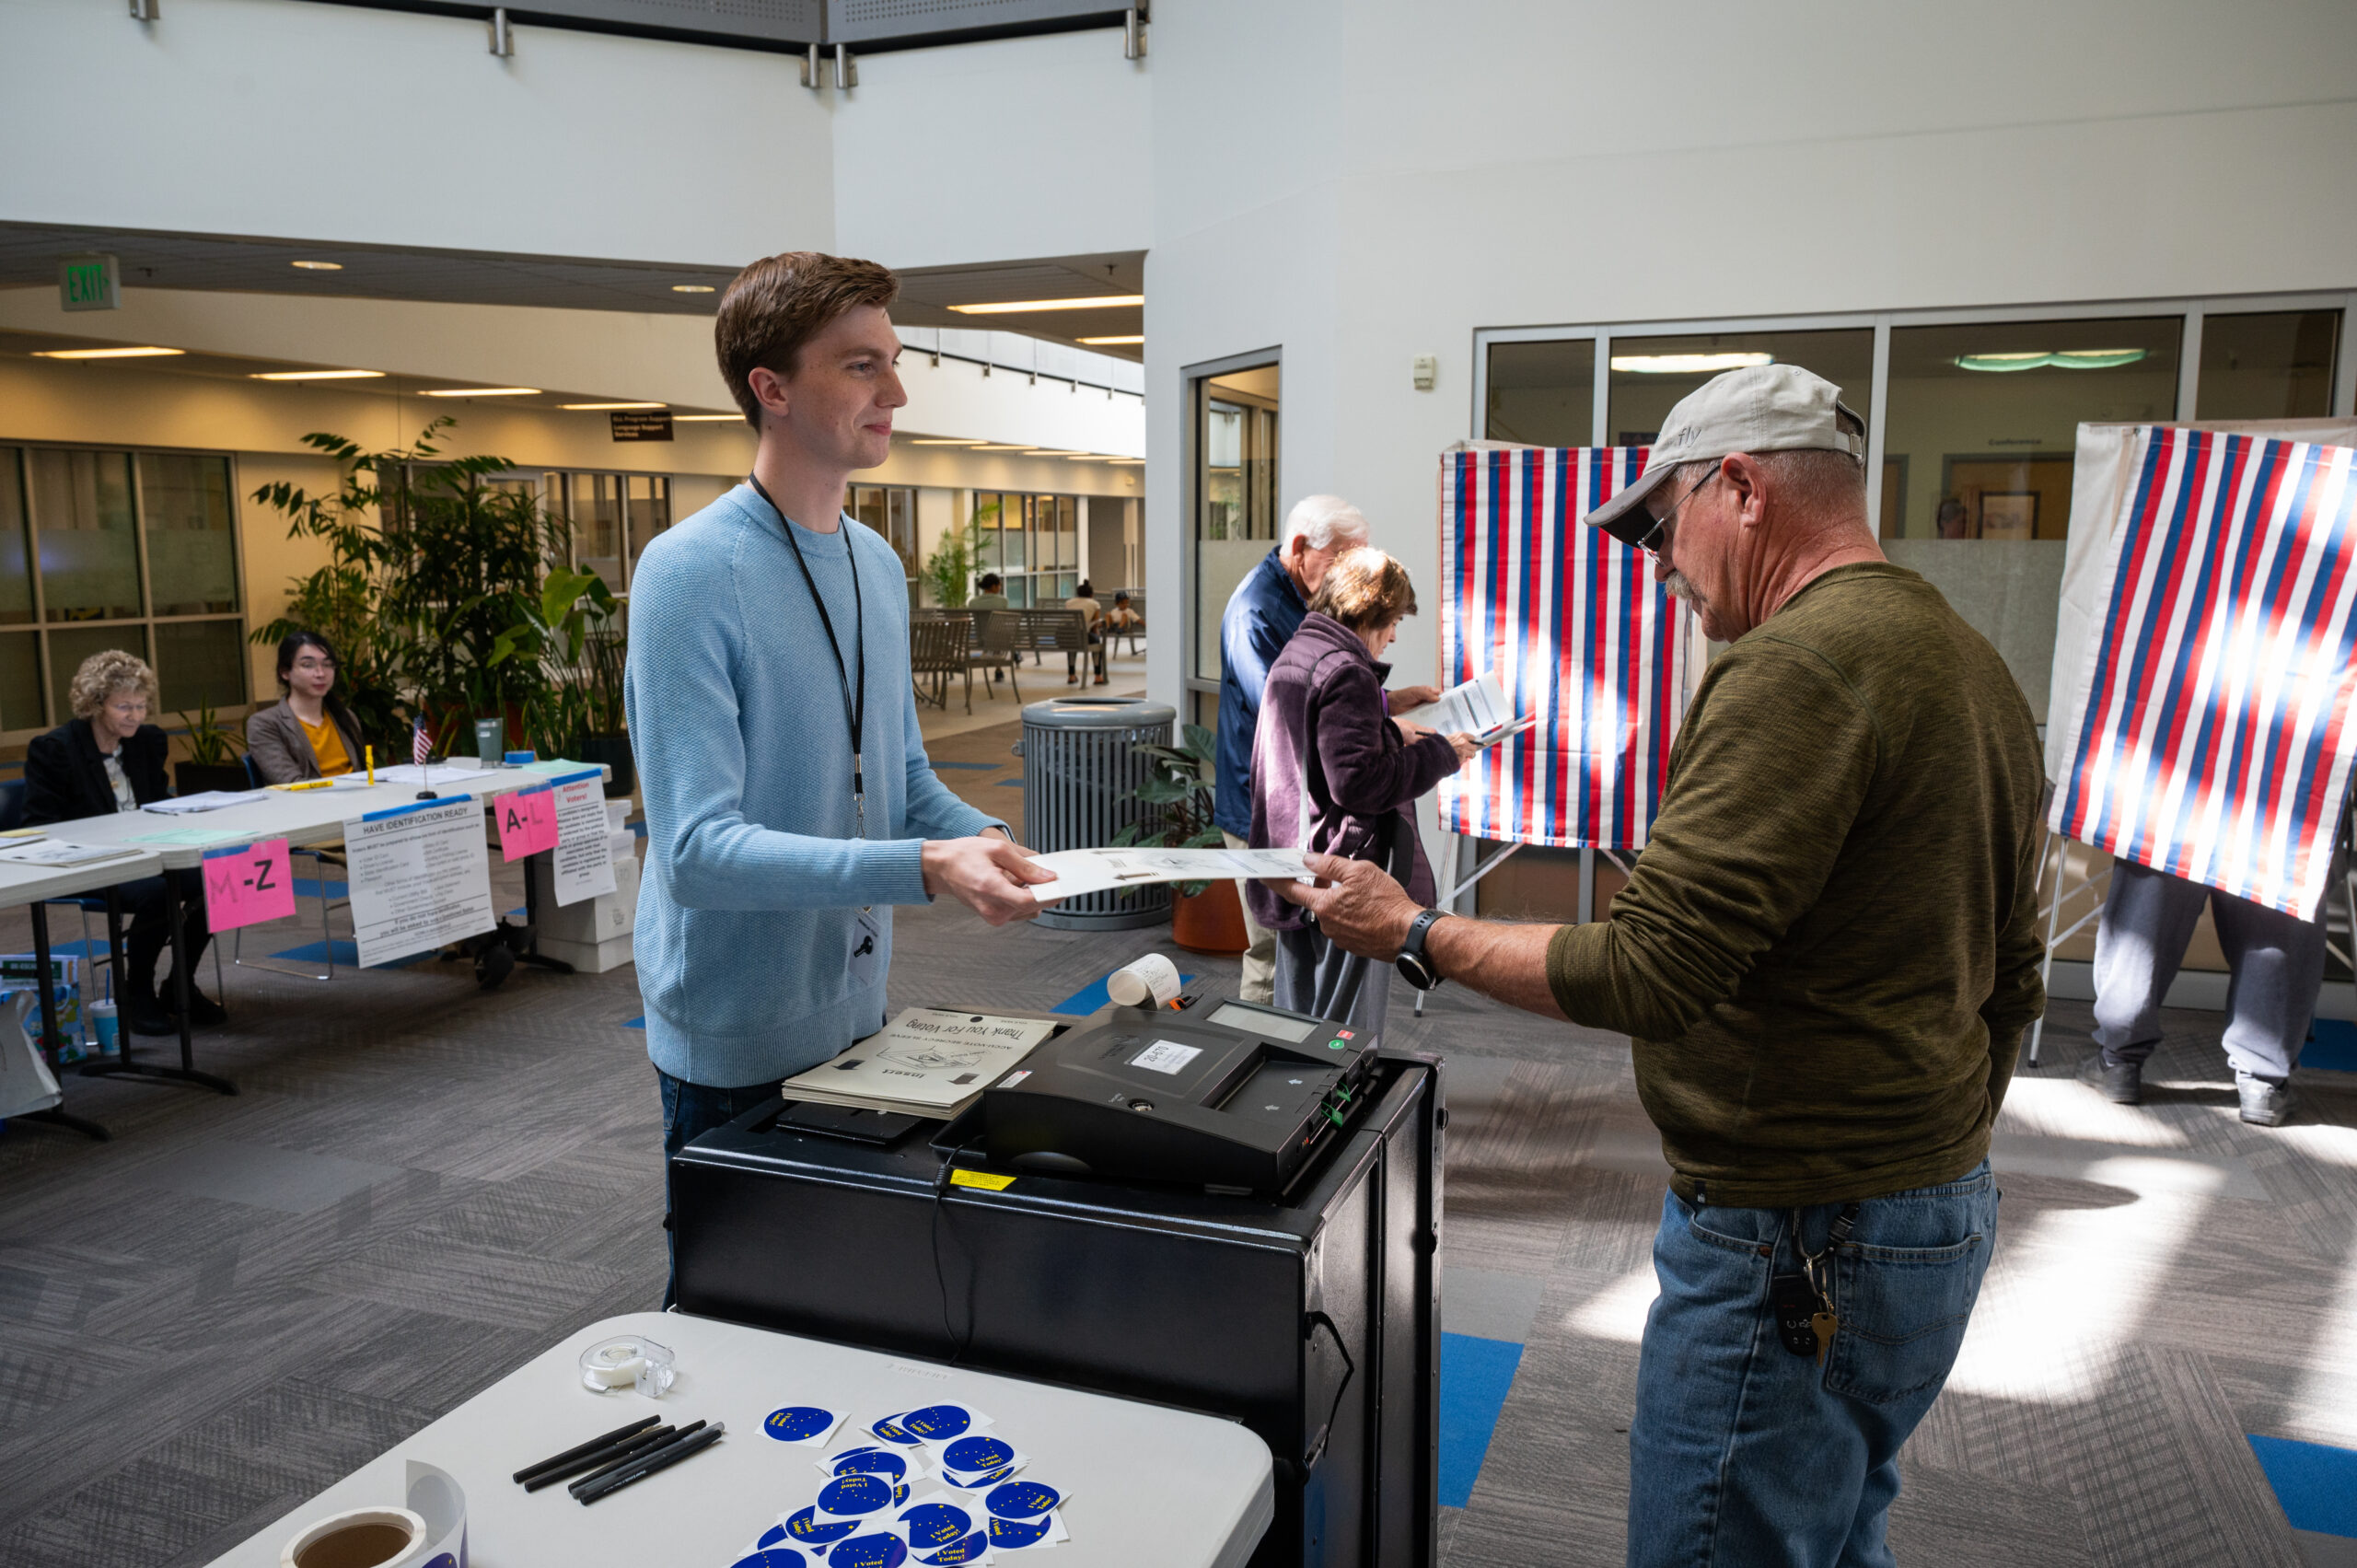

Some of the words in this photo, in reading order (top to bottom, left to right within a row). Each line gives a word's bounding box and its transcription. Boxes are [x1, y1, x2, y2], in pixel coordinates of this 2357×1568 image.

[66, 265, 103, 302] EXIT
[1988, 437, 2042, 447] Conference
[562, 782, 589, 793] Attention
[566, 794, 587, 803] Voters!
[362, 822, 384, 834] HAVE
[385, 811, 443, 830] IDENTIFICATION
[443, 806, 468, 819] READY
[210, 859, 275, 905] M-Z
[906, 1017, 940, 1034] Voting
[941, 1024, 965, 1035] For
[965, 1026, 991, 1037] You
[991, 1026, 1024, 1040] Thank
[881, 1068, 924, 1079] Insert
[980, 1454, 999, 1462] Voted
[981, 1458, 1004, 1468] Today!
[935, 1525, 956, 1536] Voted
[935, 1528, 961, 1543] Today!
[943, 1548, 965, 1556] Voted
[860, 1559, 883, 1567] Voted
[937, 1554, 965, 1562] Today!
